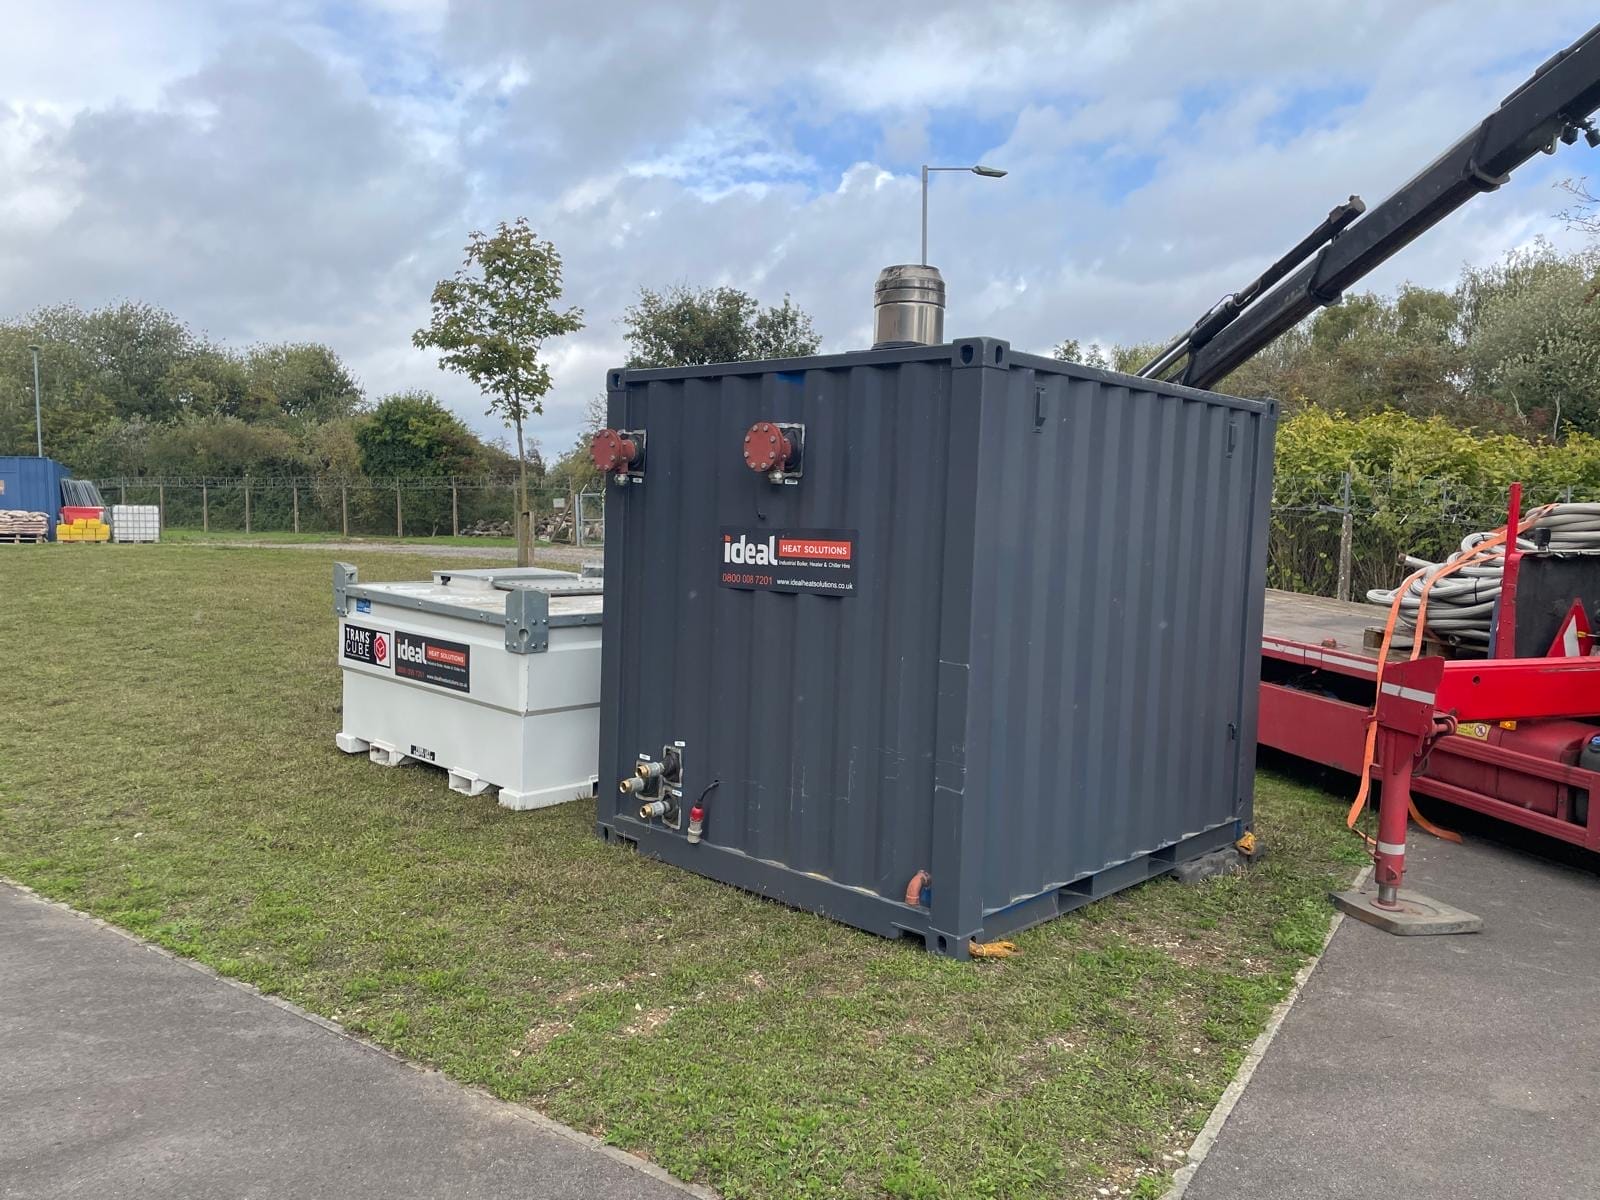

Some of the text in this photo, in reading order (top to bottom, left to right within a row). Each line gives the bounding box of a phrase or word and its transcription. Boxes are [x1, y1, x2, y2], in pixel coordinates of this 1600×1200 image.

[724, 534, 778, 566] ideal
[782, 544, 847, 555] HEAT SOLUTIONS
[723, 573, 740, 583] 0800
[755, 575, 772, 585] 7201
[777, 579, 853, 590] www.idealheatsolutions.co.uk
[346, 627, 370, 644] TRANS
[346, 640, 370, 657] CUBE
[397, 638, 427, 665] ideal
